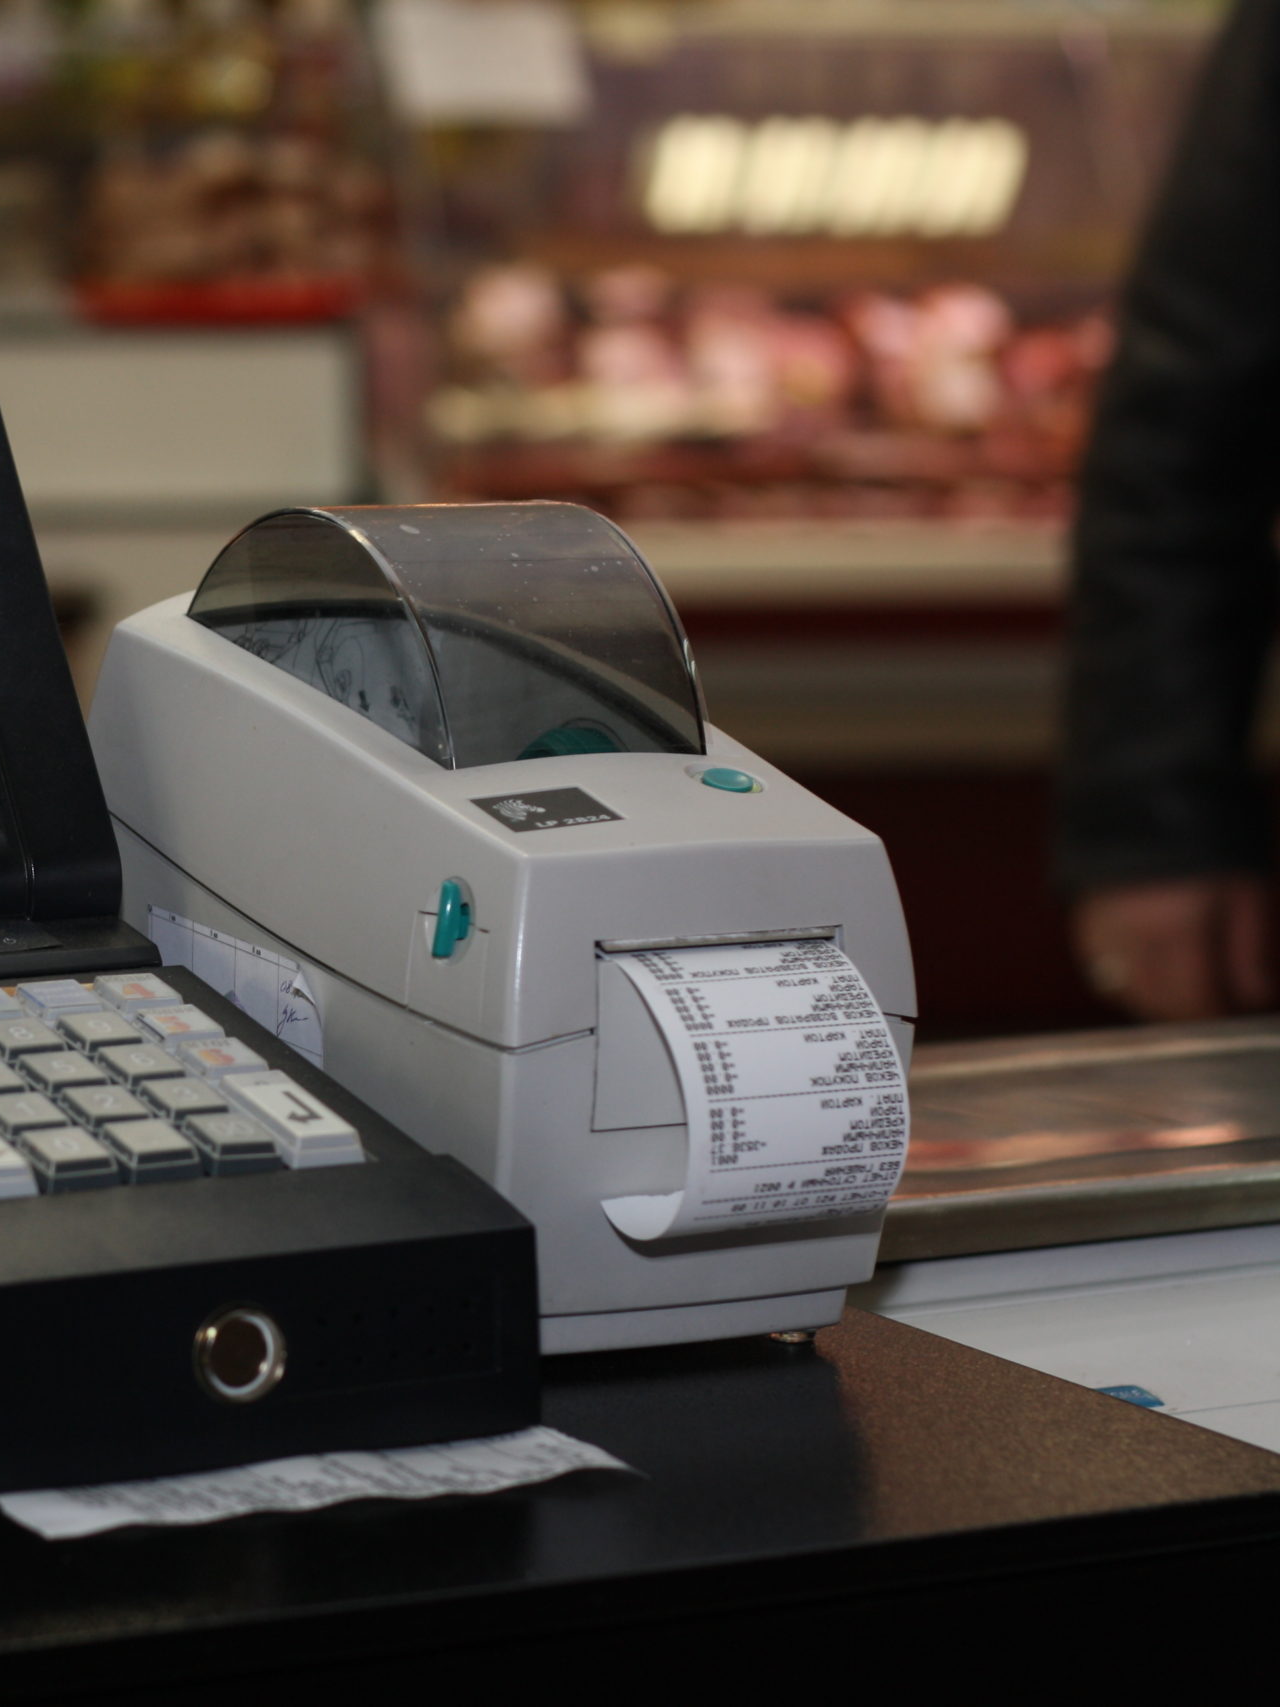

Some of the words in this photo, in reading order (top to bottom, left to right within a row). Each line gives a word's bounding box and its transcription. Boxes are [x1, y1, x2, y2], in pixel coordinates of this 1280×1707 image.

[535, 820, 558, 828] LP
[563, 814, 611, 824] 2824
[865, 1071, 899, 1082] ЧЕКОВ
[870, 1140, 904, 1151] ЧЕКОВ
